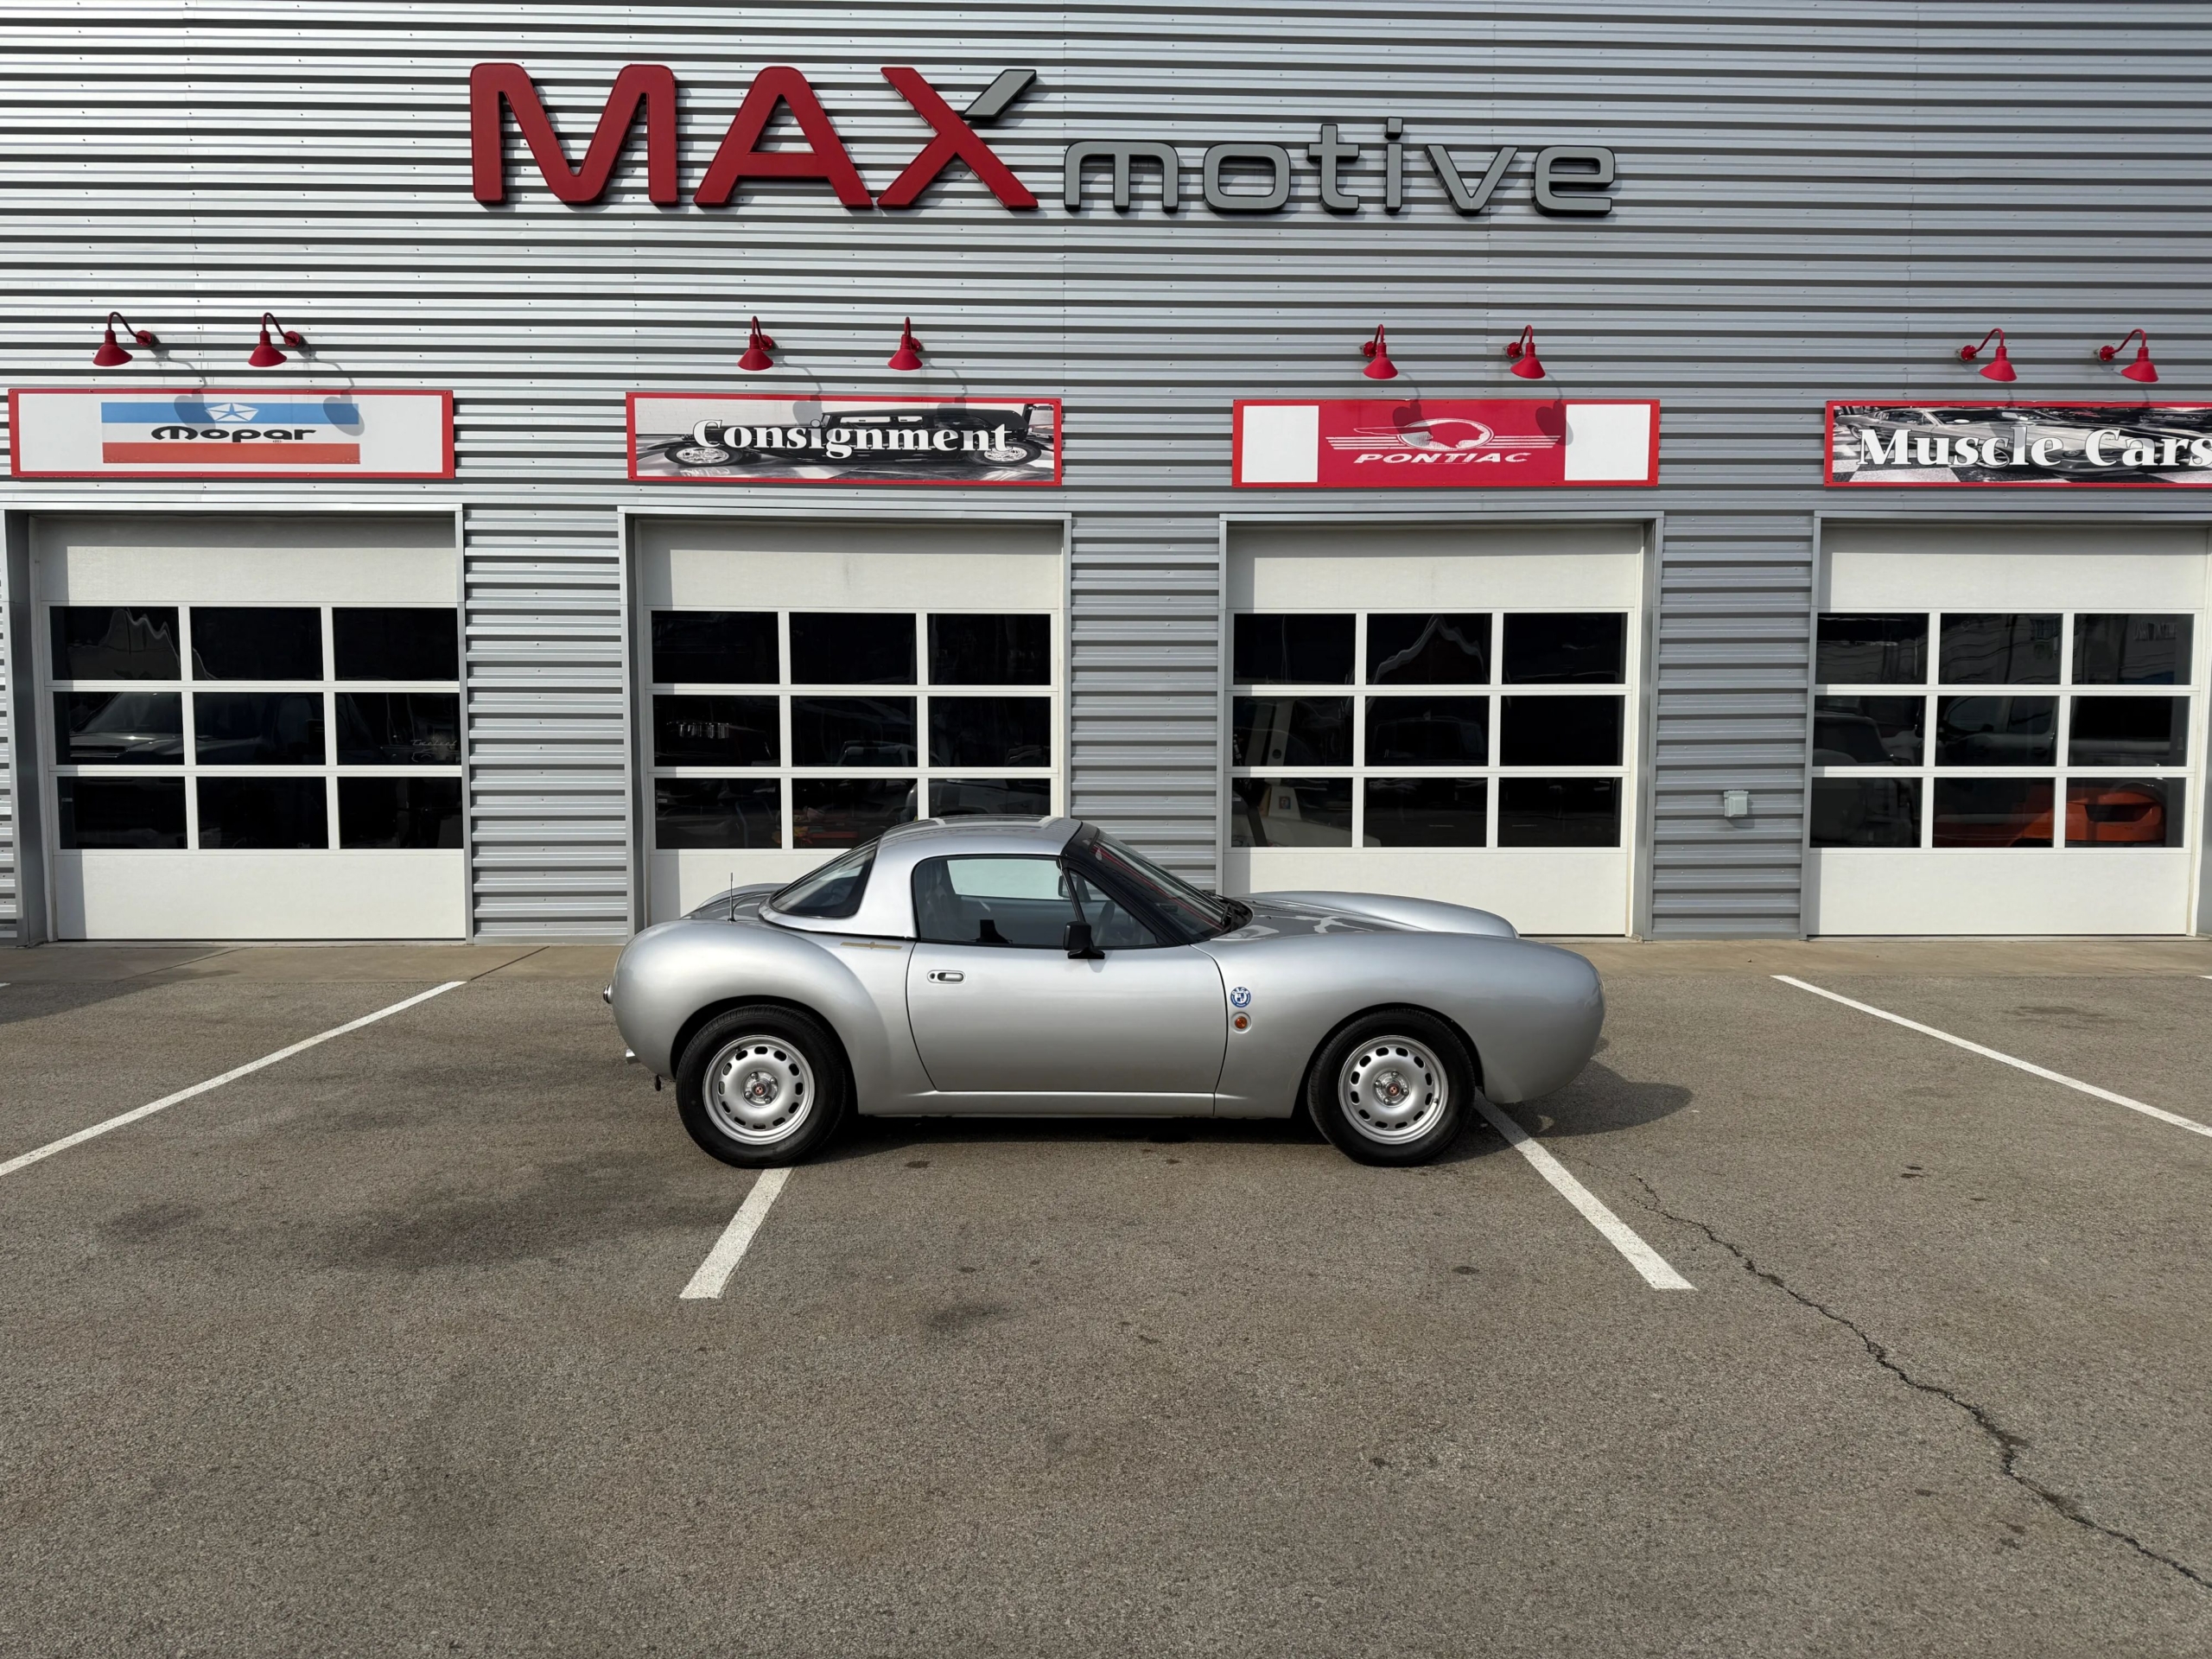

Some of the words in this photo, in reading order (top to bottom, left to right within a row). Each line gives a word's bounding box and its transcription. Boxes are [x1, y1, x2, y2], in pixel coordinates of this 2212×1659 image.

[470, 62, 1039, 210] MAX
[1064, 117, 1617, 216] motive
[693, 419, 1013, 459] Consignment
[1353, 452, 1531, 463] PONTIAC
[1857, 425, 2064, 467] Muscle
[2084, 429, 2212, 467] Cars
